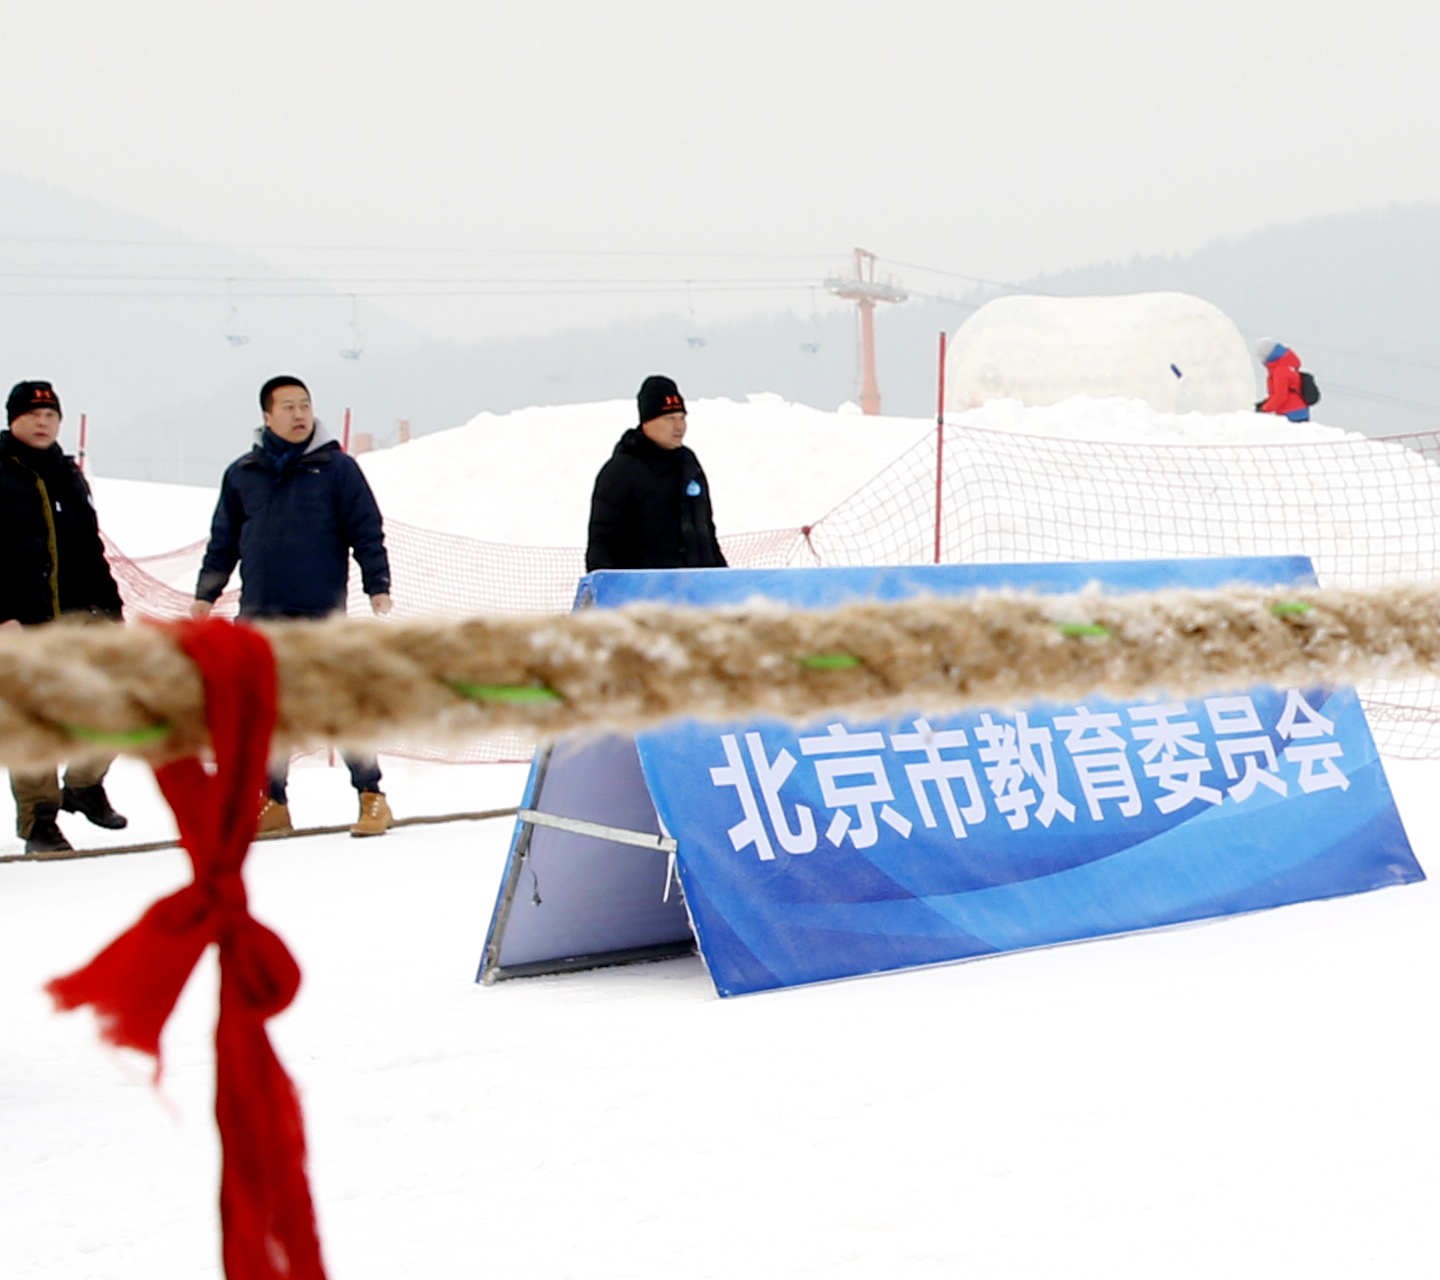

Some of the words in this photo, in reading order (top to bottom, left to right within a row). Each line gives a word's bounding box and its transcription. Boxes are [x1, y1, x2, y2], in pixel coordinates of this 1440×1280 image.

[709, 687, 1351, 861] 北京市教育委员会
